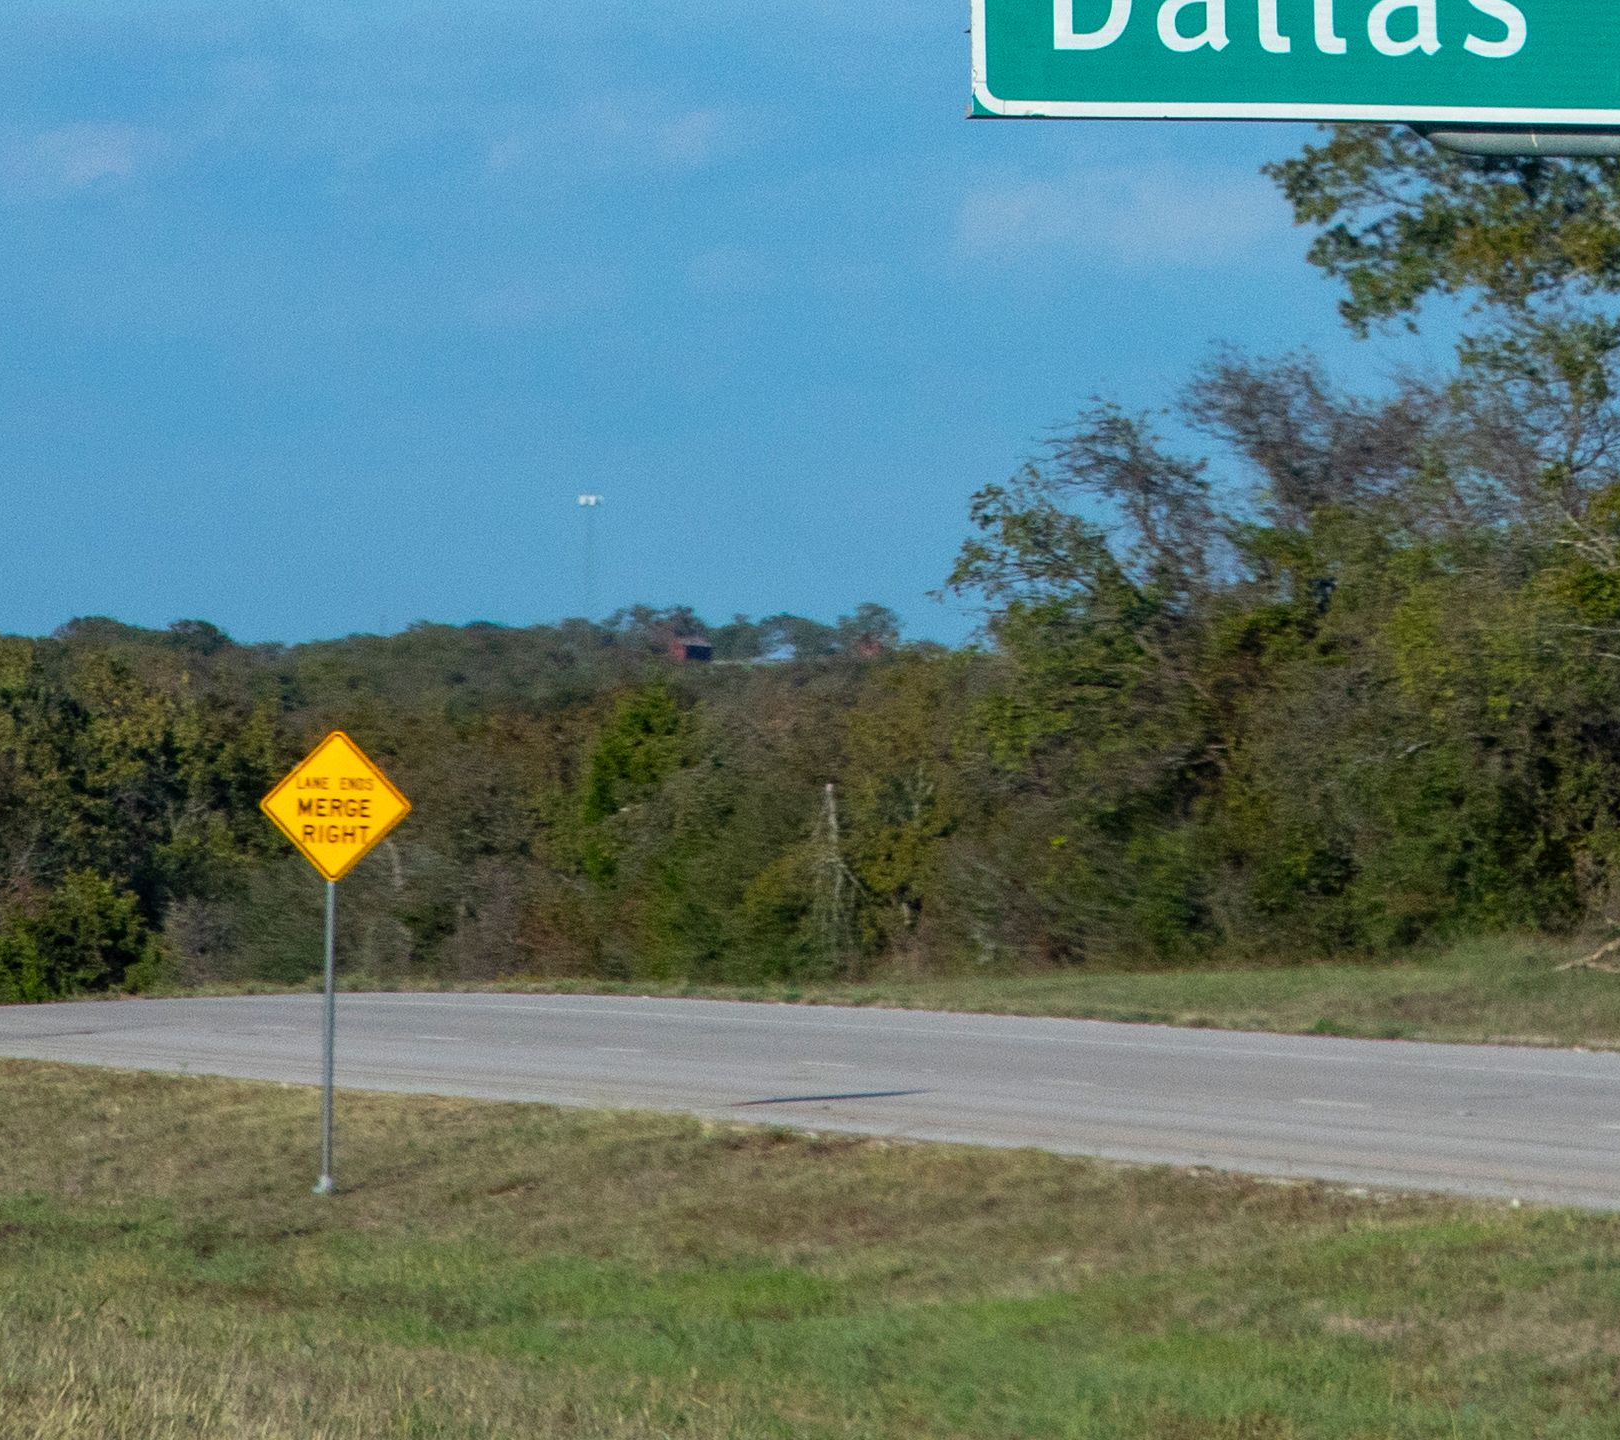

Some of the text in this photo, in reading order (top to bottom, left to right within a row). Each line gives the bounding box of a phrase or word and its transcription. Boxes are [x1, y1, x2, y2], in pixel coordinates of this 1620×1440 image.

[296, 777, 374, 791] LANE ENDS
[297, 798, 372, 818] MERGE
[302, 825, 372, 844] RIGHT
